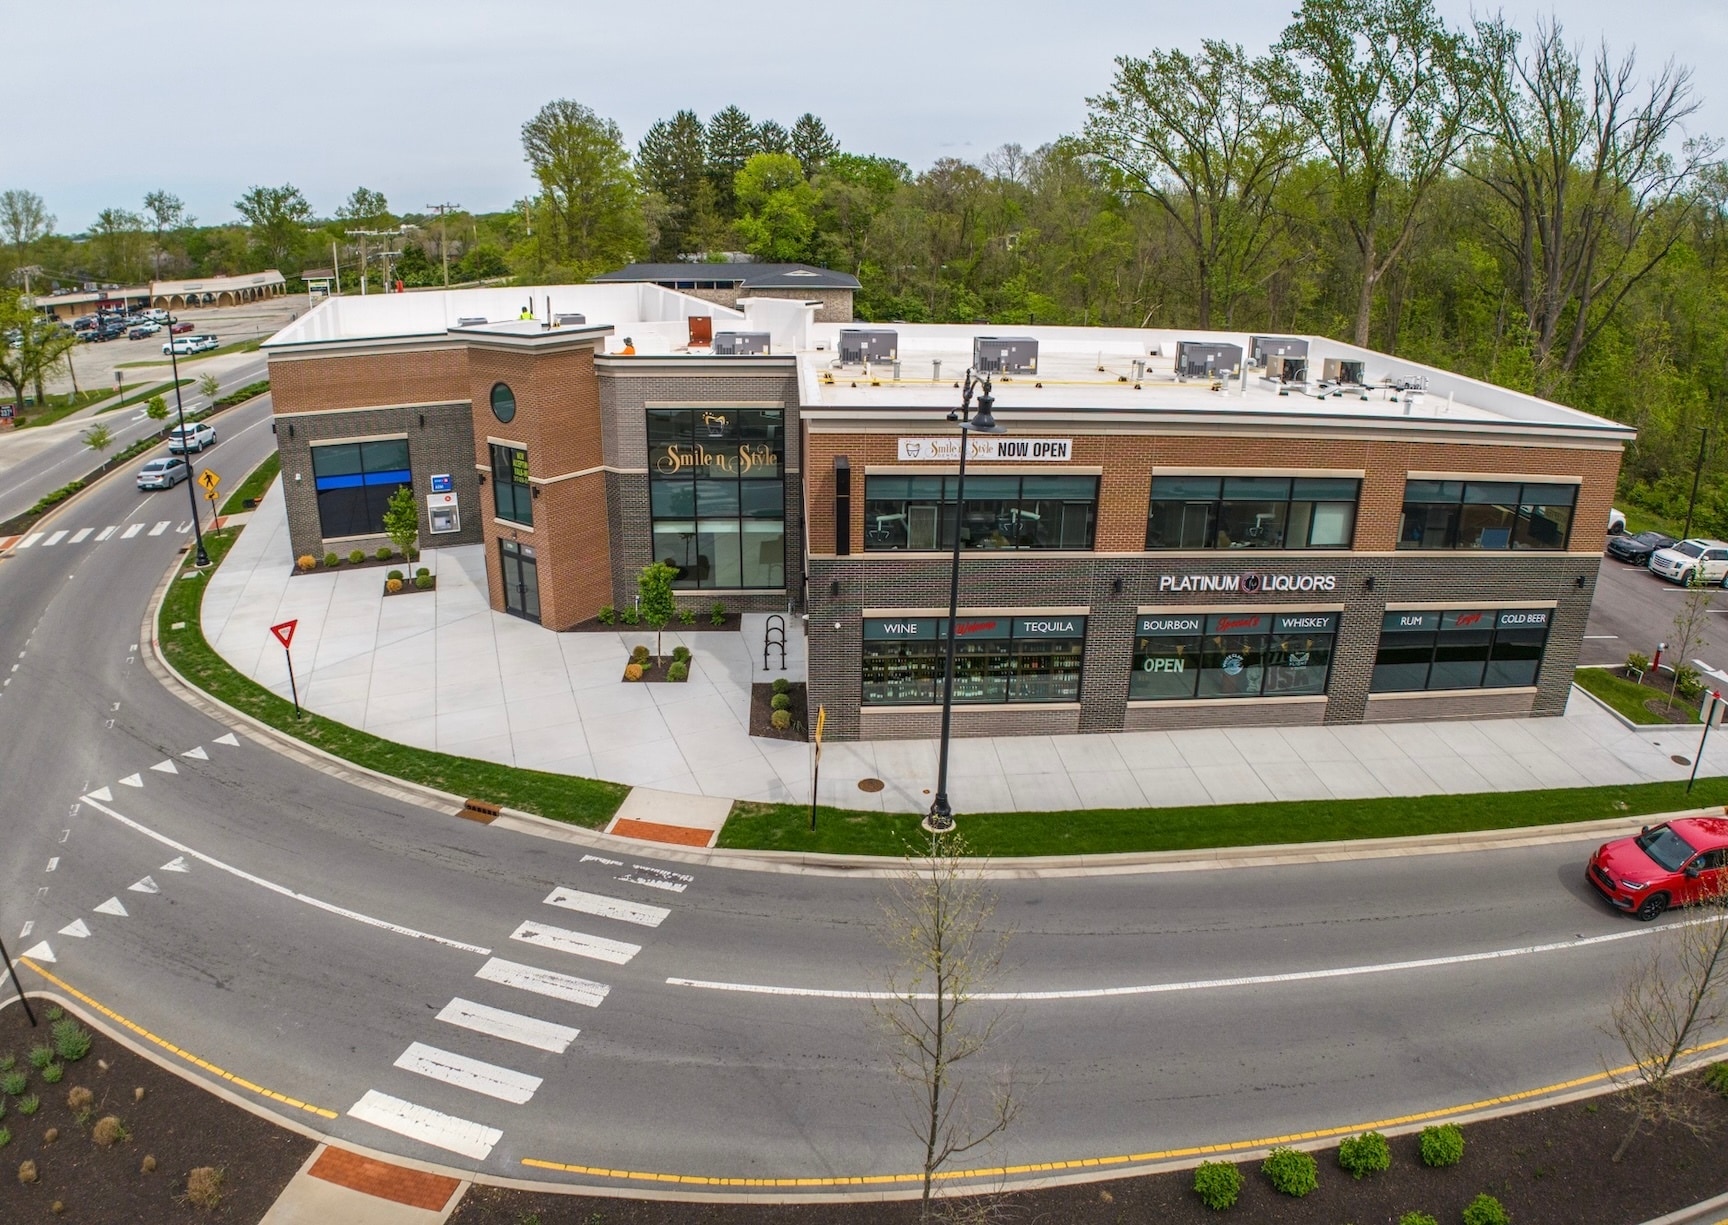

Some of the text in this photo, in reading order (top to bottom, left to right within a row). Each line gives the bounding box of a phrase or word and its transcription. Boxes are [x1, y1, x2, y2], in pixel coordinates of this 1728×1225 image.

[926, 440, 957, 458] Smile
[970, 440, 994, 458] Style
[998, 442, 1029, 458] NOW
[1033, 442, 1067, 458] OPEN
[657, 443, 713, 474] Smile
[728, 443, 778, 474] Style
[1159, 575, 1336, 591] PLATINUM LIQUORS
[1281, 617, 1330, 629] WHISKEY
[1400, 616, 1423, 626] RUM
[1501, 613, 1546, 624] COLD BEER
[883, 623, 918, 634] WINE
[1023, 621, 1074, 633] TEQUILA
[1143, 620, 1199, 631] BOURBON
[1143, 658, 1185, 673] OPEN
